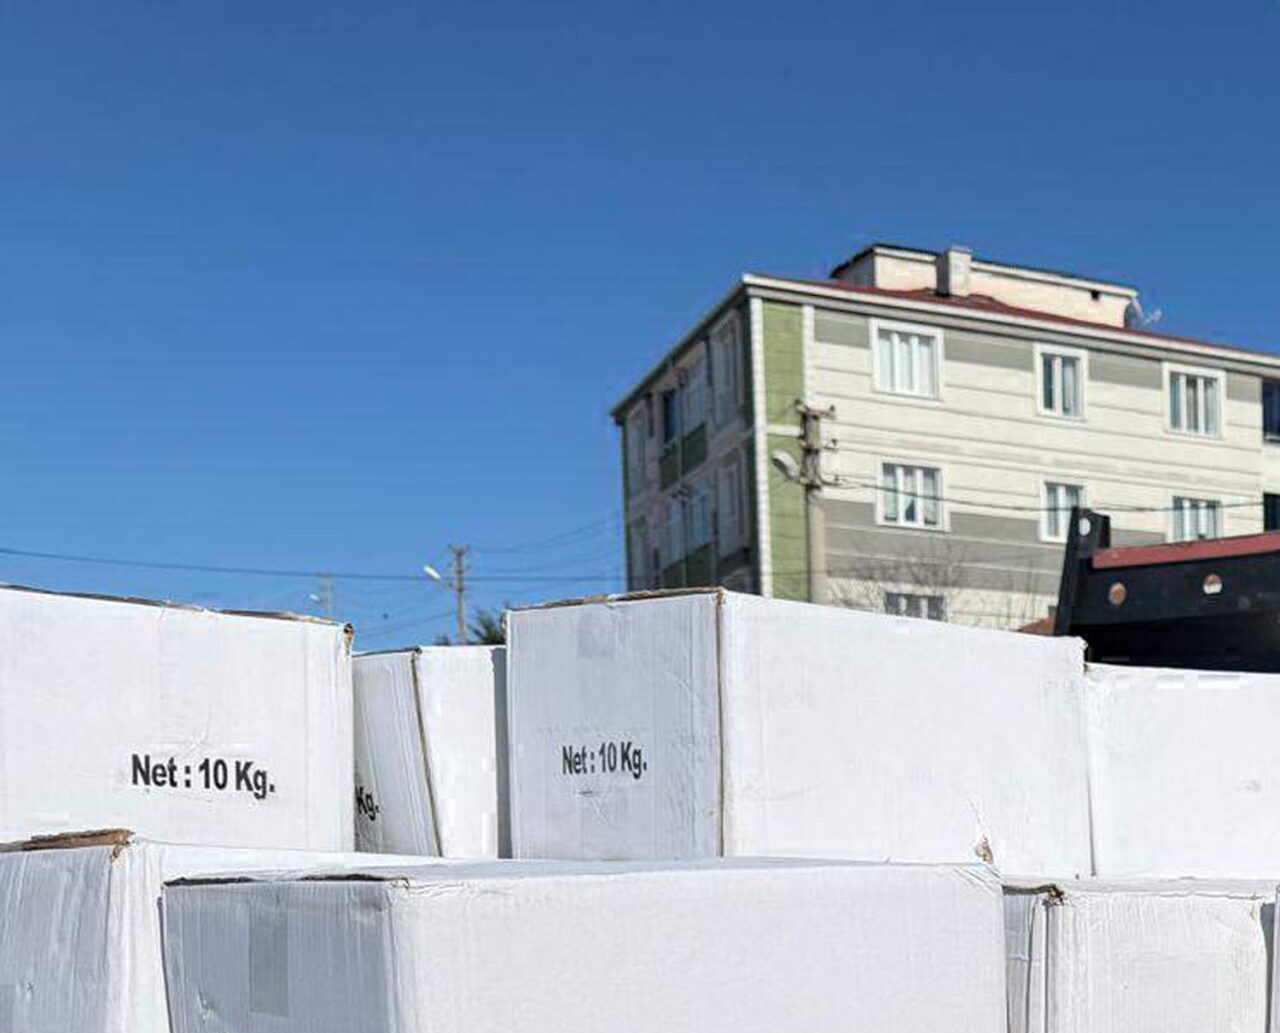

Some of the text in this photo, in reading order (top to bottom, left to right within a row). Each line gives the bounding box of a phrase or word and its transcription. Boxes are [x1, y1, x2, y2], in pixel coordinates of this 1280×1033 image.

[131, 754, 177, 787] Net
[199, 758, 228, 790] 10
[235, 761, 275, 800] Kg.
[562, 745, 587, 775] Net
[599, 742, 617, 773] 10
[621, 741, 647, 780] Kg.
